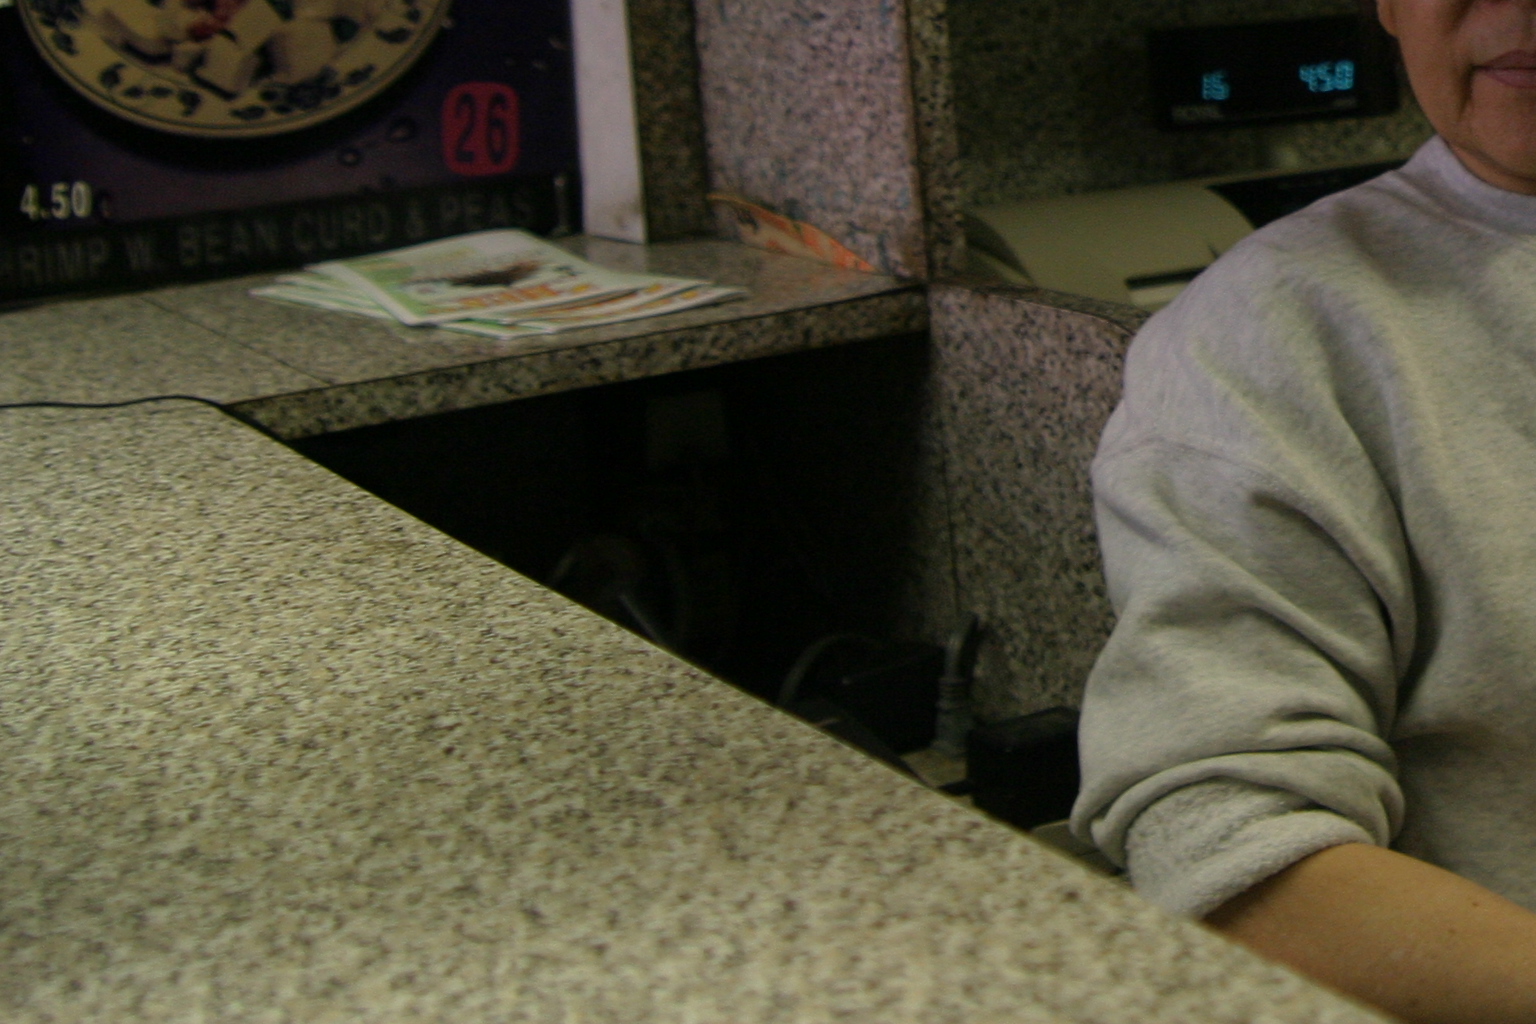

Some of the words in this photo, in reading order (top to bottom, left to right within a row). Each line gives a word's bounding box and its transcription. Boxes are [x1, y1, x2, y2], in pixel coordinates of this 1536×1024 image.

[454, 92, 507, 164] 26
[19, 180, 93, 221] 4.50
[178, 219, 280, 267] BEAN
[292, 205, 390, 254] CURD
[441, 189, 535, 230] PEAS
